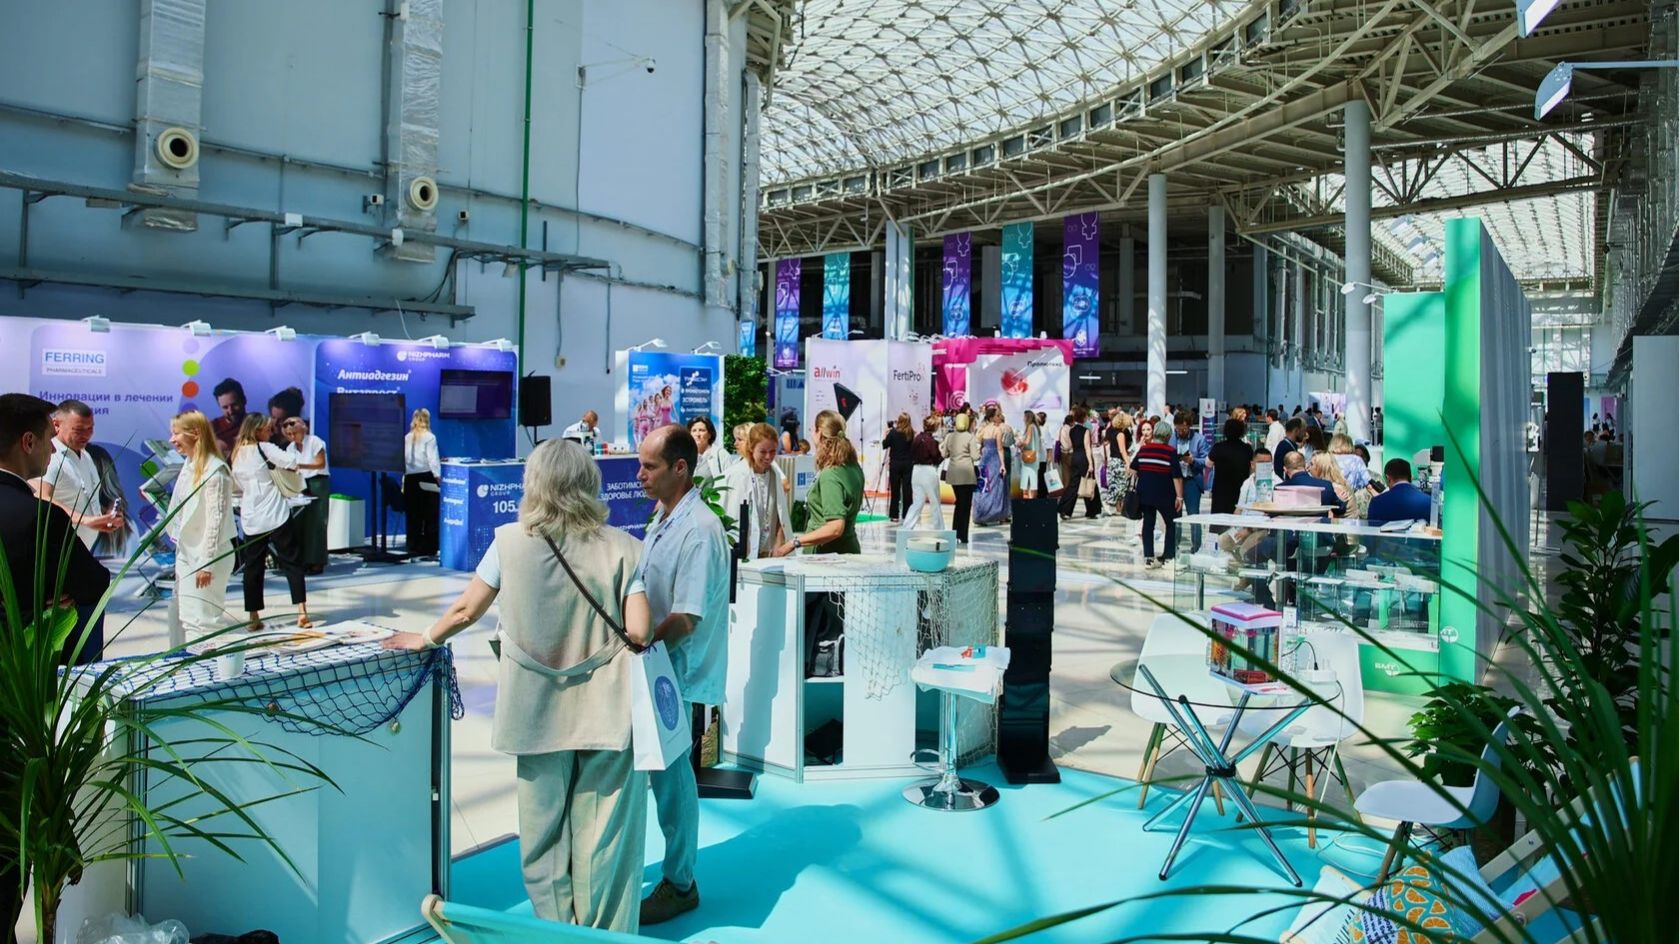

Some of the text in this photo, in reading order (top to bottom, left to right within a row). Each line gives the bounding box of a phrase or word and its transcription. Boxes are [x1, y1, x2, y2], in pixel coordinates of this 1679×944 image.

[45, 351, 105, 364] FERRING
[814, 367, 840, 378] allwin
[893, 370, 921, 381] FertiPro
[39, 391, 110, 402] Инновации
[125, 395, 173, 403] лечении
